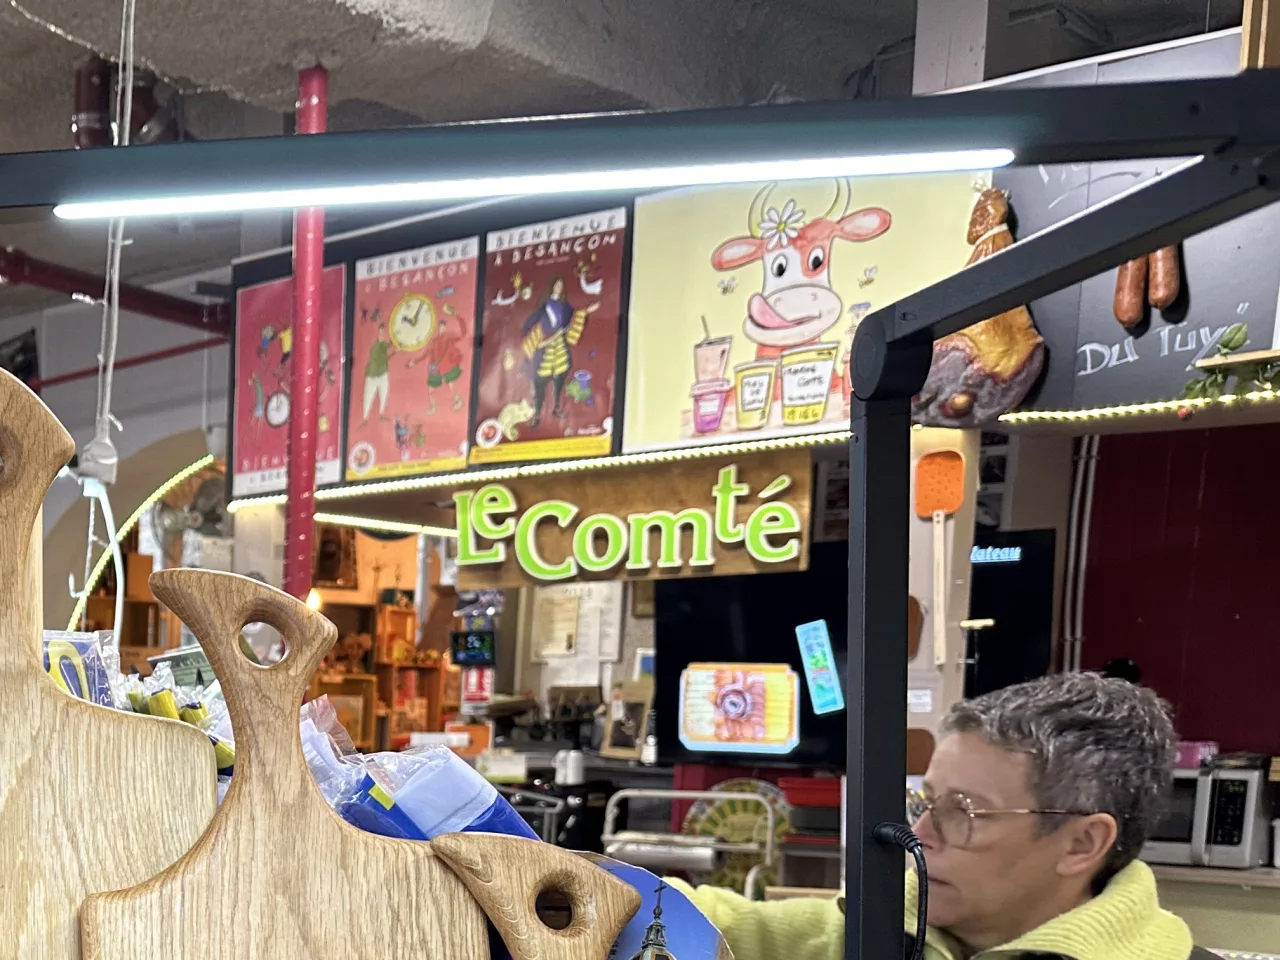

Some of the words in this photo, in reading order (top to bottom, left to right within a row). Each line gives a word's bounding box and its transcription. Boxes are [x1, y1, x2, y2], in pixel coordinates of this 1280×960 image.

[452, 483, 519, 567] Le
[515, 464, 802, 581] Comté
[970, 545, 1022, 563] lateau
